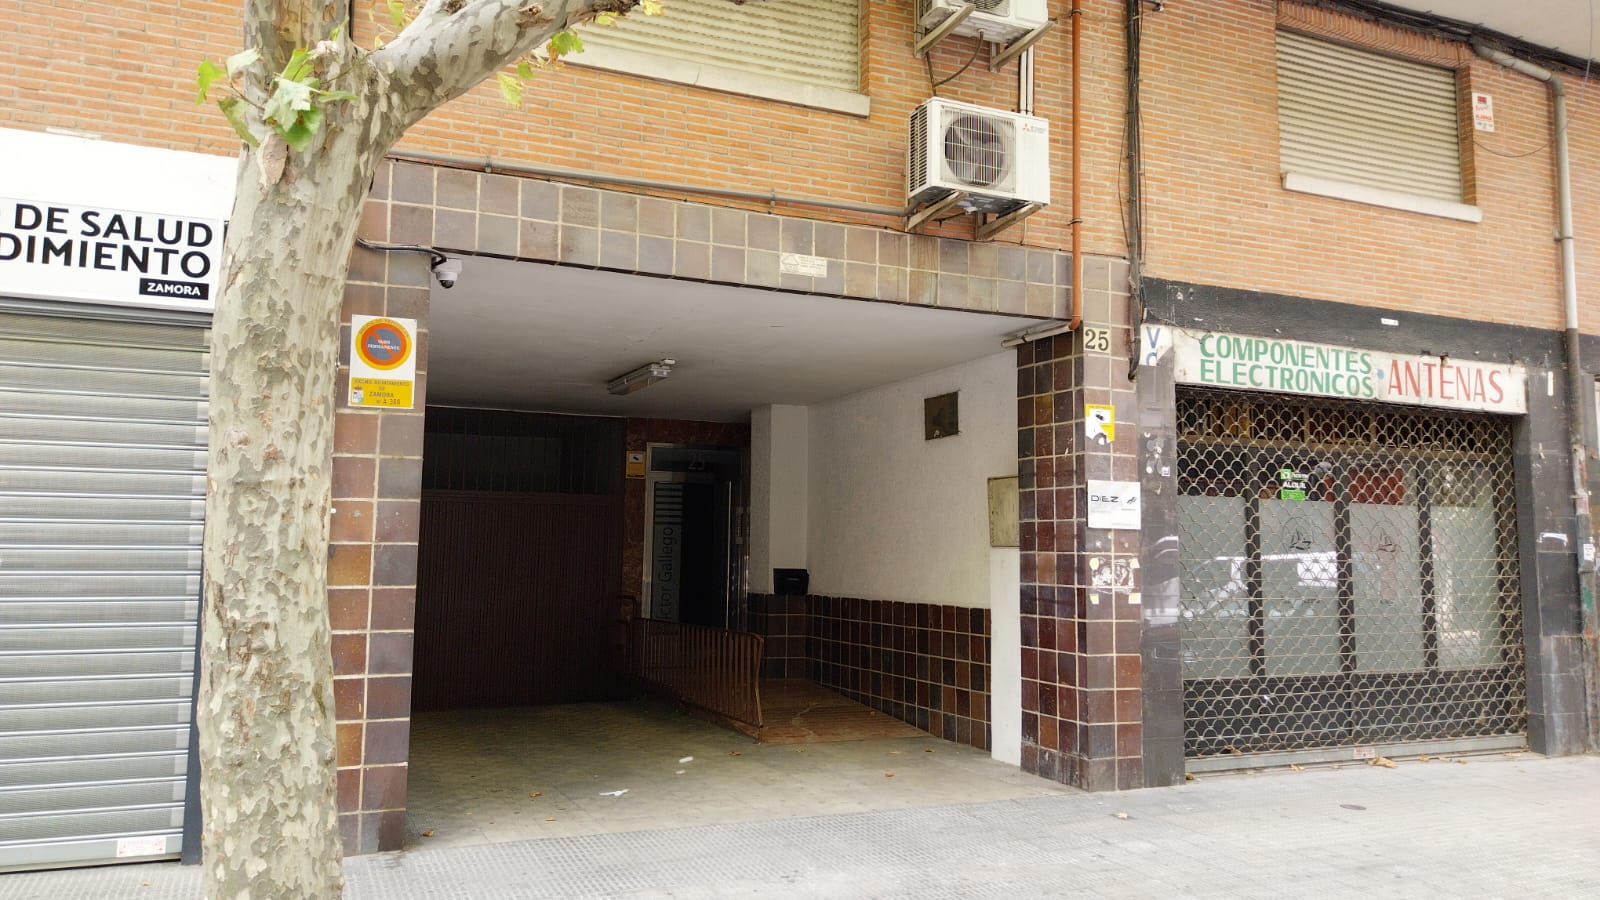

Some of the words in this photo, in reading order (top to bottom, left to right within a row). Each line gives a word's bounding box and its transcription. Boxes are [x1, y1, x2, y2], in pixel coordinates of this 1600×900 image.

[14, 203, 69, 234] DE
[80, 210, 213, 247] SALUD
[0, 232, 211, 279] DIMIENTO
[147, 282, 201, 296] ZAMORA
[1084, 328, 1109, 351] 25
[1200, 334, 1372, 374] COMPONENTES
[1200, 359, 1374, 399] ELECTRONICOS
[1388, 359, 1504, 404] ANTENAS
[657, 527, 678, 582] Gallego
